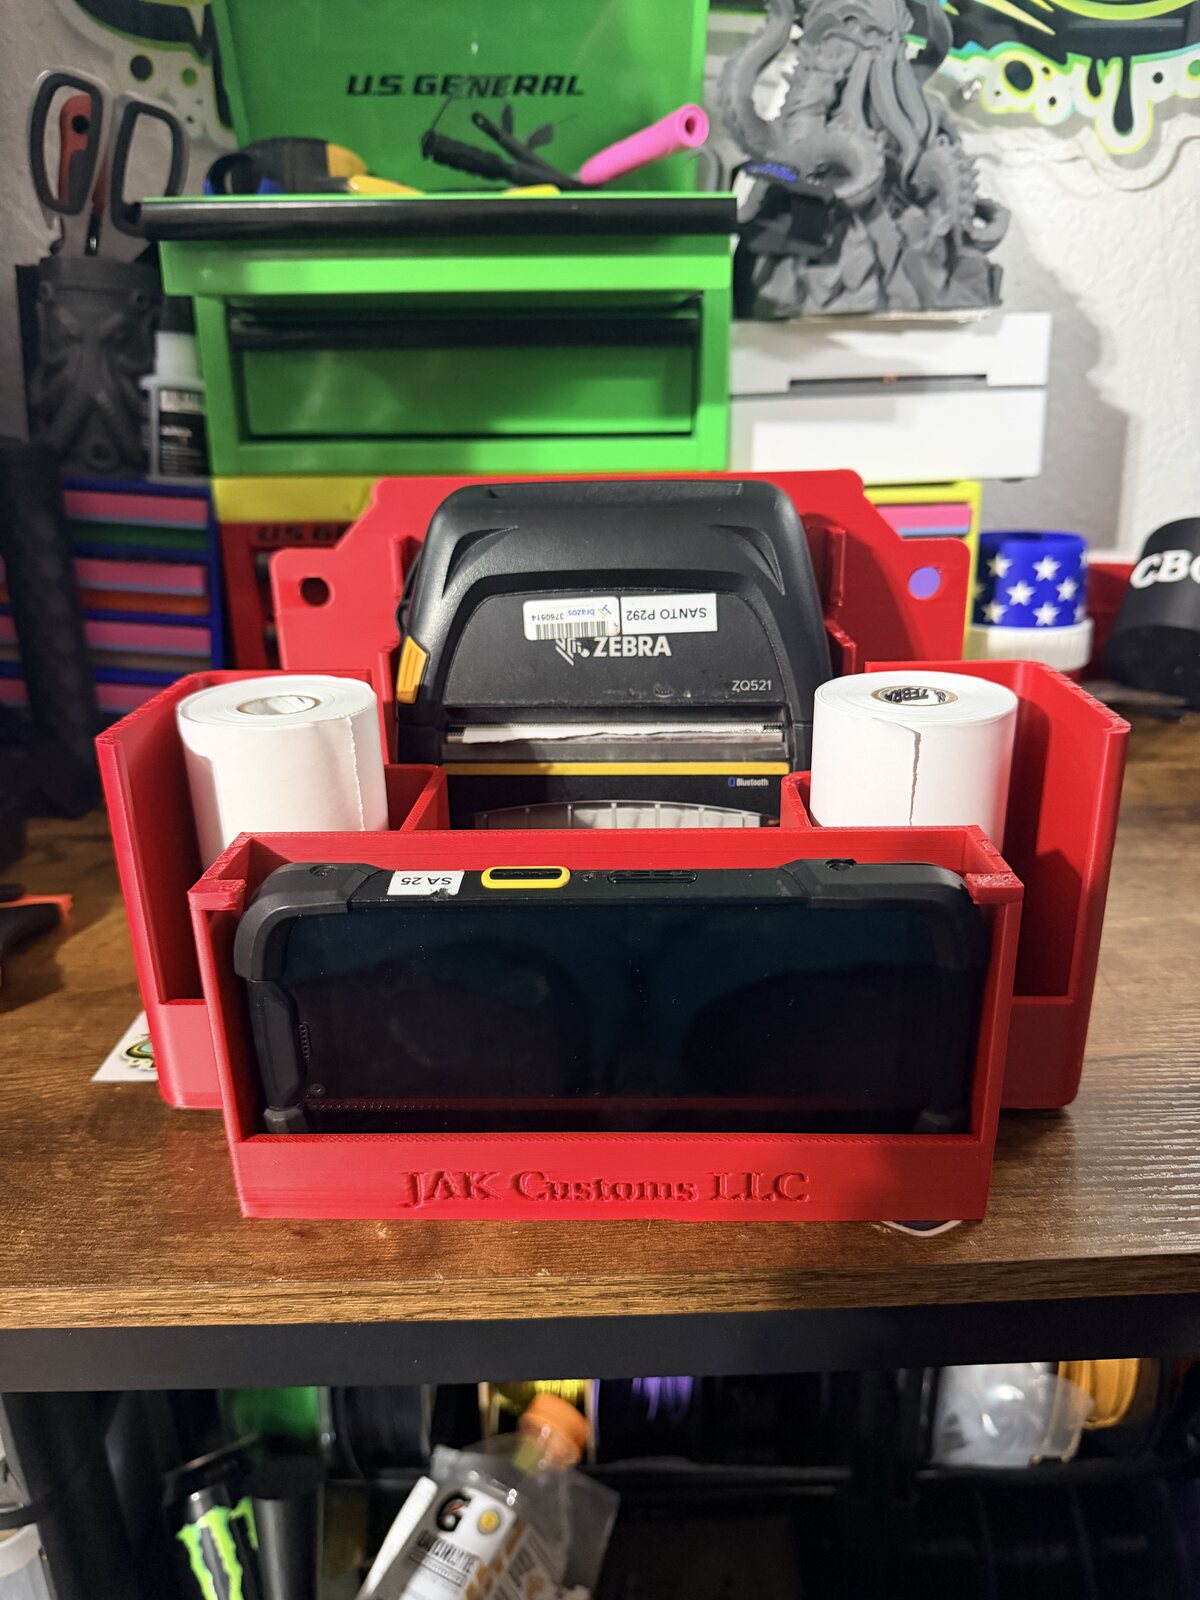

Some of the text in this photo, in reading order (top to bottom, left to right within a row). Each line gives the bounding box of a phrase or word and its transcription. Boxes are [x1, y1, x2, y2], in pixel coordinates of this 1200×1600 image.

[412, 73, 585, 98] GENERAL
[565, 608, 595, 618] brazos
[626, 607, 707, 621] SANTO P292
[592, 635, 673, 658] ZEBRA
[731, 679, 773, 693] ZQ521
[736, 777, 770, 787] Bluetooth
[400, 876, 454, 886] SA 25
[400, 1170, 812, 1209] JAK Customs LLC
